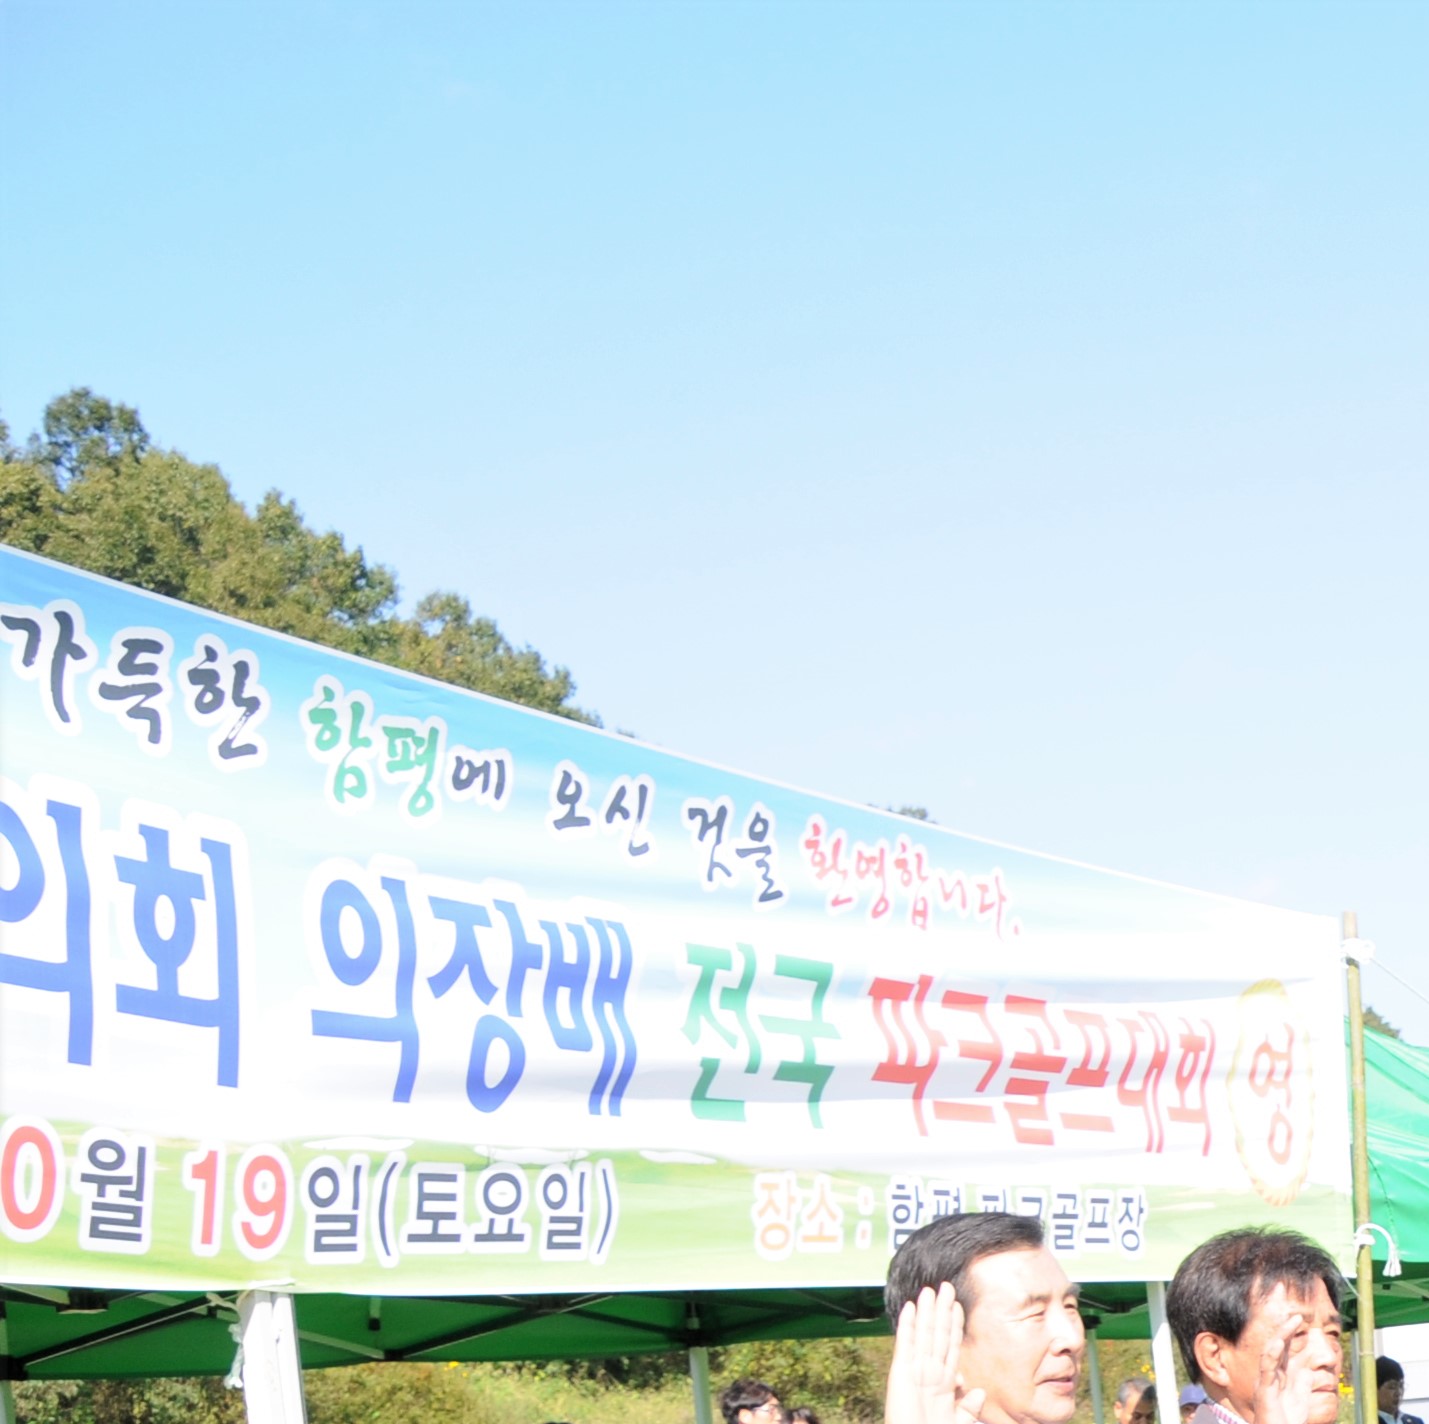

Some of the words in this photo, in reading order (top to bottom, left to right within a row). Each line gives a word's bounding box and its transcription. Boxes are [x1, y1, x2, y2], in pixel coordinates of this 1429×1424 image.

[1, 610, 261, 760] 가득한
[307, 685, 506, 817] 함평에
[552, 769, 651, 857] 오신
[687, 804, 784, 902] 것을
[804, 822, 1024, 938] 환영합니다.
[310, 875, 638, 1117] 의장배
[680, 942, 842, 1130] 전국
[867, 974, 1217, 1157] 파크골프대회
[190, 1149, 614, 1258] 19일(토요일)
